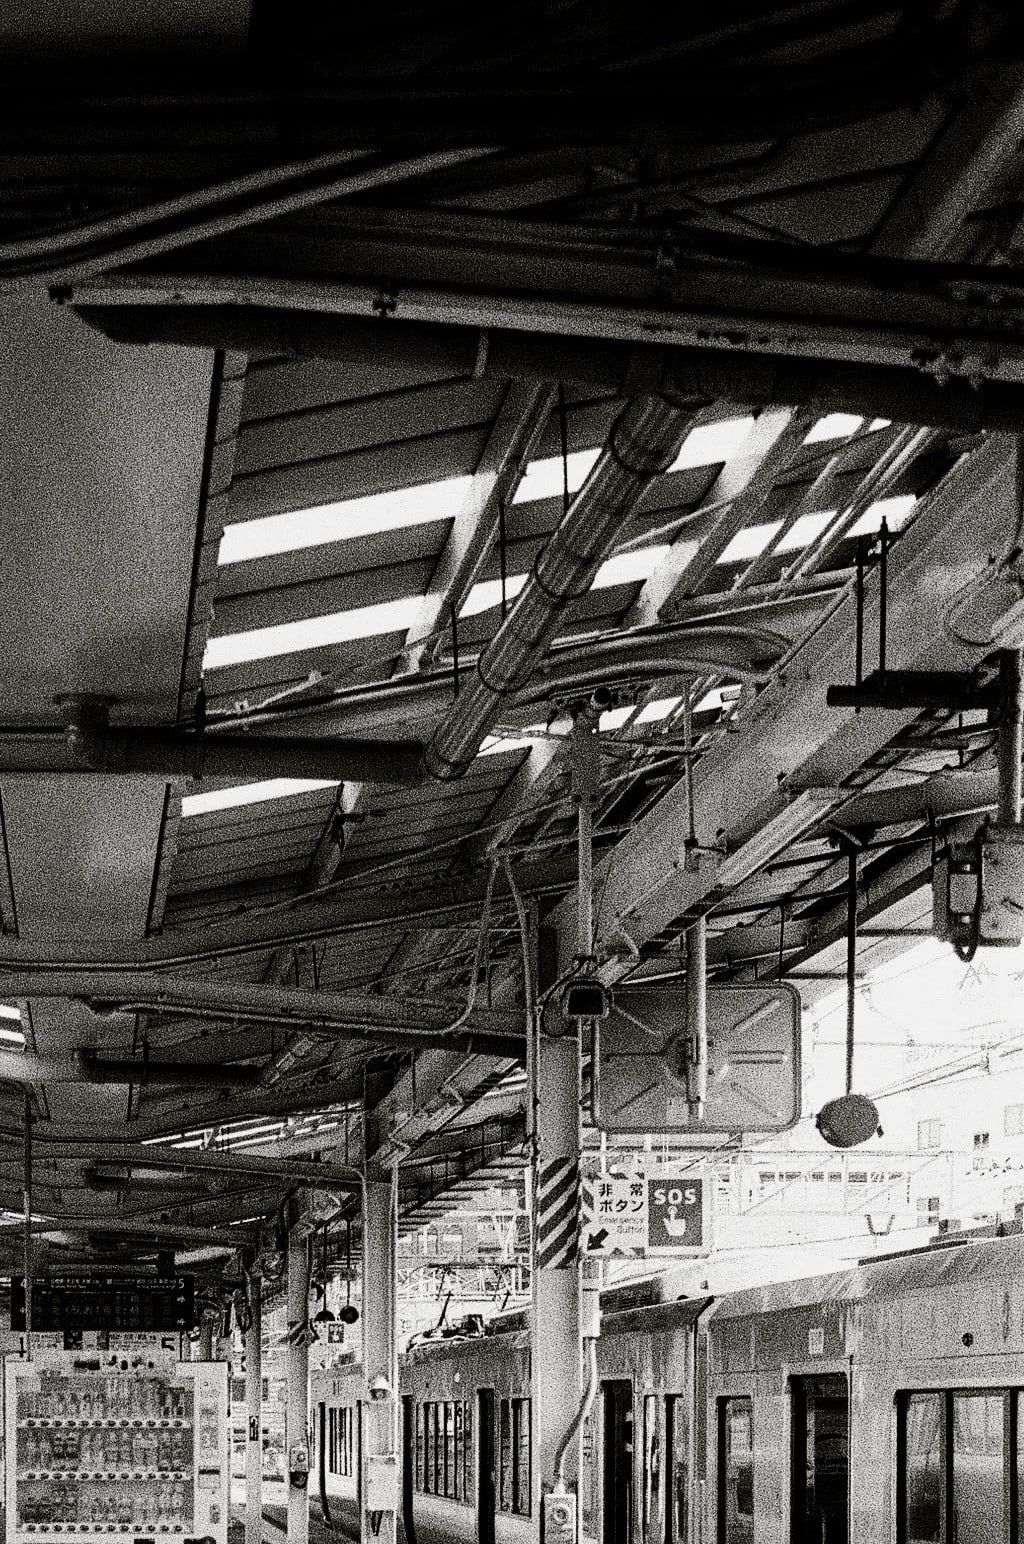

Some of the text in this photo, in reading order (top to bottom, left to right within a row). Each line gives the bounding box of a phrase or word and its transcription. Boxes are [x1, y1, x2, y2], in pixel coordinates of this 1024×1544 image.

[599, 1183, 644, 1197] 非常
[654, 1188, 697, 1205] SOS
[599, 1199, 644, 1213] ボタン
[178, 1278, 185, 1289] 5
